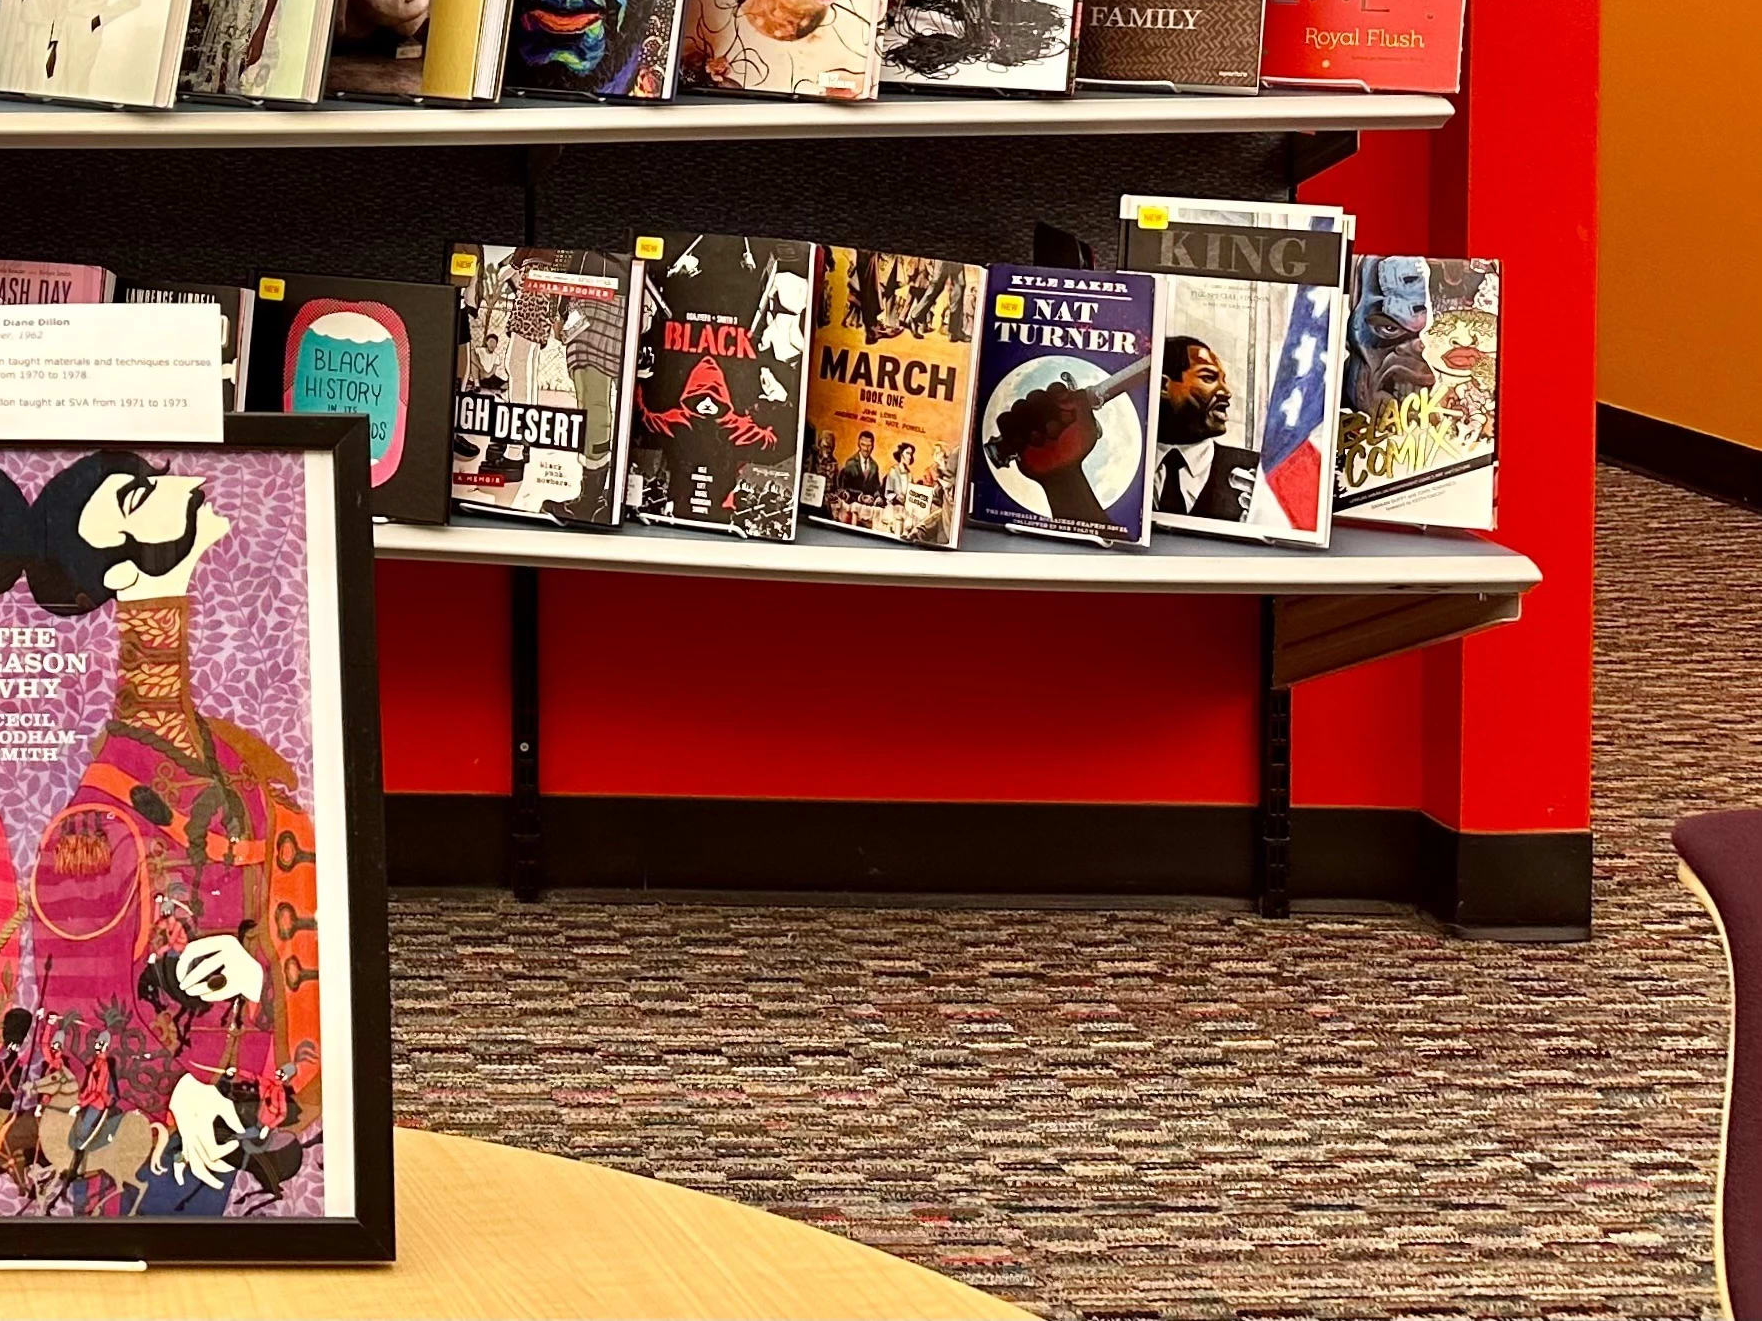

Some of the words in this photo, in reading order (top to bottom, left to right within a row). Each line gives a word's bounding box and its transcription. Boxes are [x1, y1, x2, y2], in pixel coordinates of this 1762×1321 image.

[1089, 7, 1202, 31] FAMILY
[1306, 27, 1360, 48] Royal
[1366, 29, 1425, 49] Flush
[1155, 230, 1310, 277] KING
[39, 280, 72, 303] DAY
[1011, 275, 1059, 288] KYLE
[1063, 278, 1128, 293] BAKER
[38, 318, 70, 326] Dillon
[1033, 298, 1099, 324] NAT
[665, 321, 757, 359] BLACK
[994, 321, 1138, 355] TURNER
[8, 358, 40, 368] taught
[44, 358, 90, 366] materials
[94, 358, 112, 366] and
[116, 358, 170, 368] techniques
[19, 370, 45, 379] 1970
[314, 348, 379, 377] BLACK
[819, 345, 957, 402] MARCH
[19, 398, 52, 409] taught
[55, 398, 66, 407] at
[93, 398, 116, 407] from
[120, 398, 144, 407] 1971
[148, 398, 158, 407] to
[305, 379, 383, 406] HISTORY
[860, 388, 884, 405] BOOK
[886, 393, 905, 409] ONE
[495, 404, 584, 449] DESERT
[1338, 383, 1464, 450] BLACK
[1345, 416, 1463, 488] COMIX
